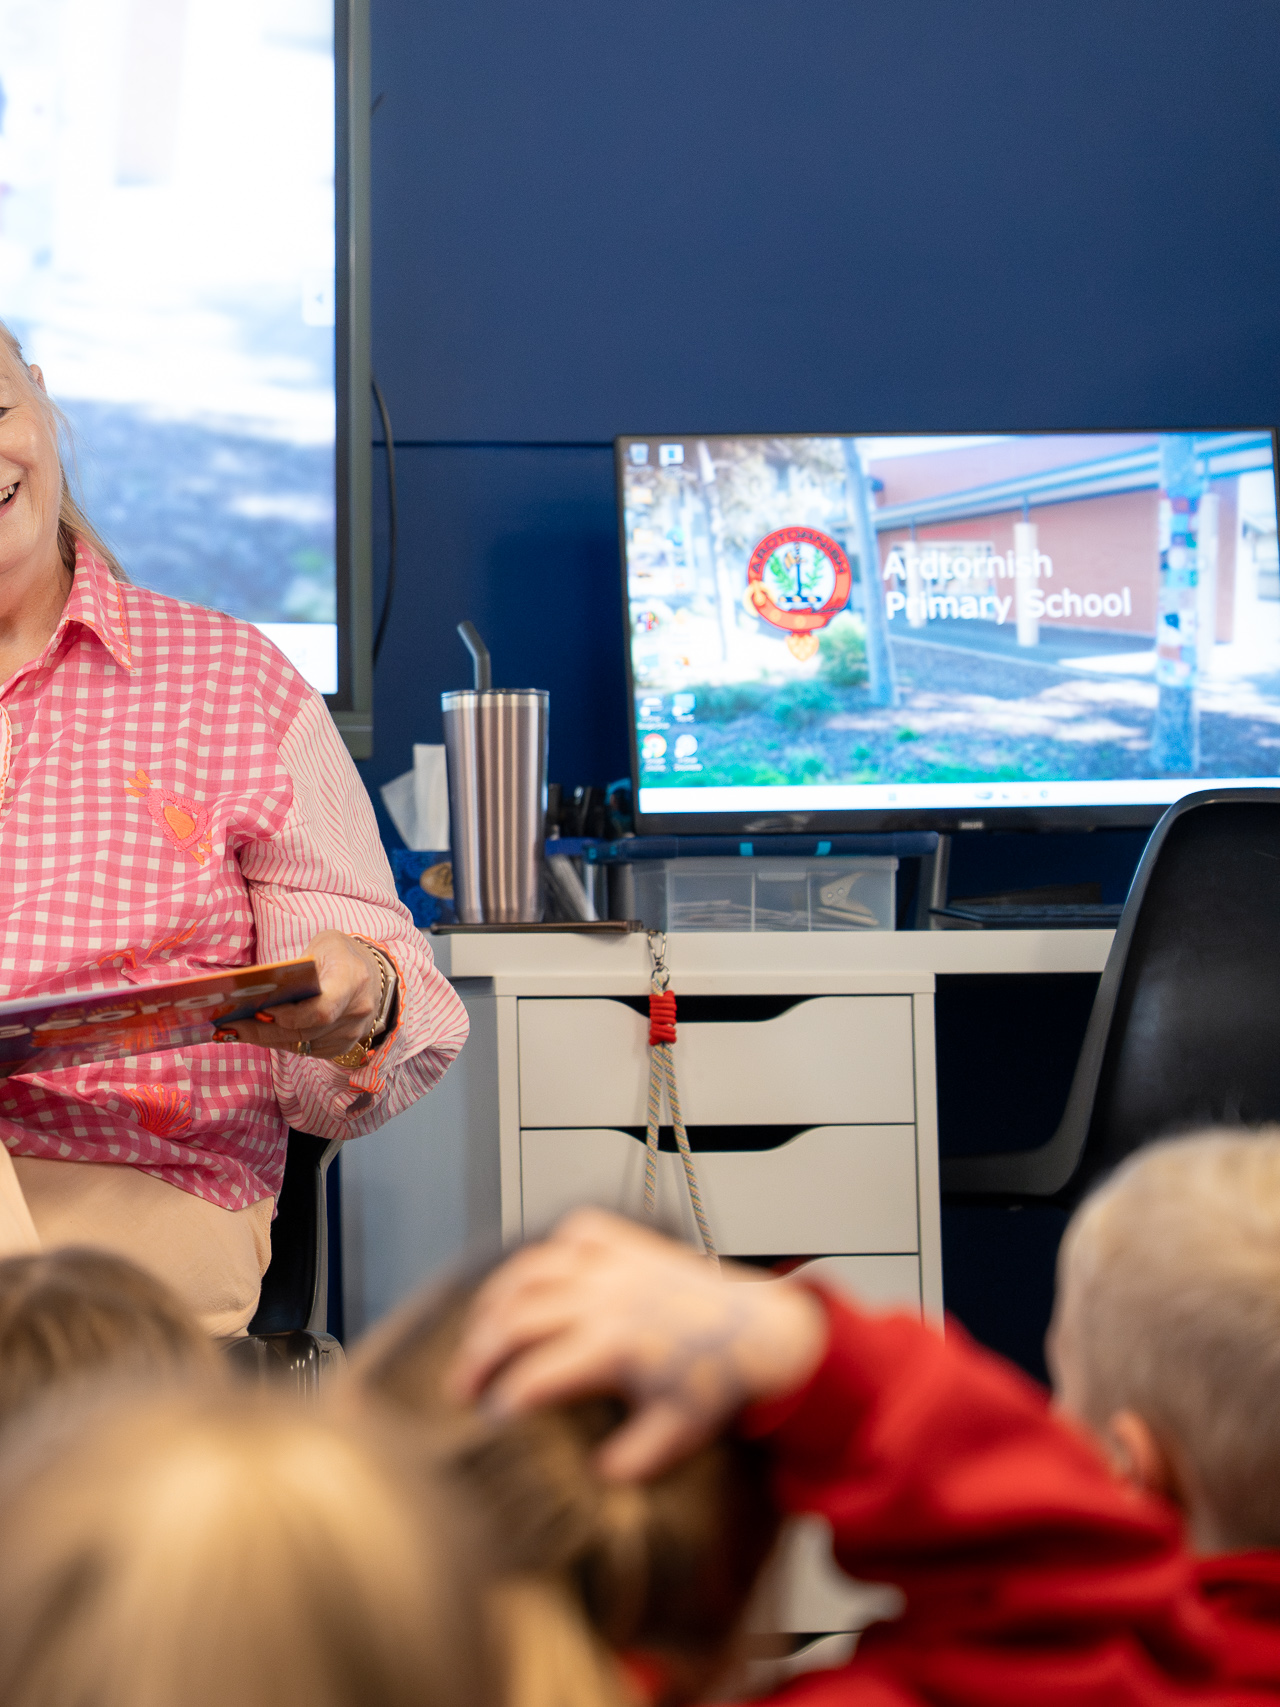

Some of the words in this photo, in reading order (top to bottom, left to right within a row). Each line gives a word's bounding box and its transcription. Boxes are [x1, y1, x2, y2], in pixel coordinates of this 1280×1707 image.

[883, 550, 1053, 581] Ardtornish
[886, 590, 1013, 625] Primary
[1023, 586, 1132, 618] School
